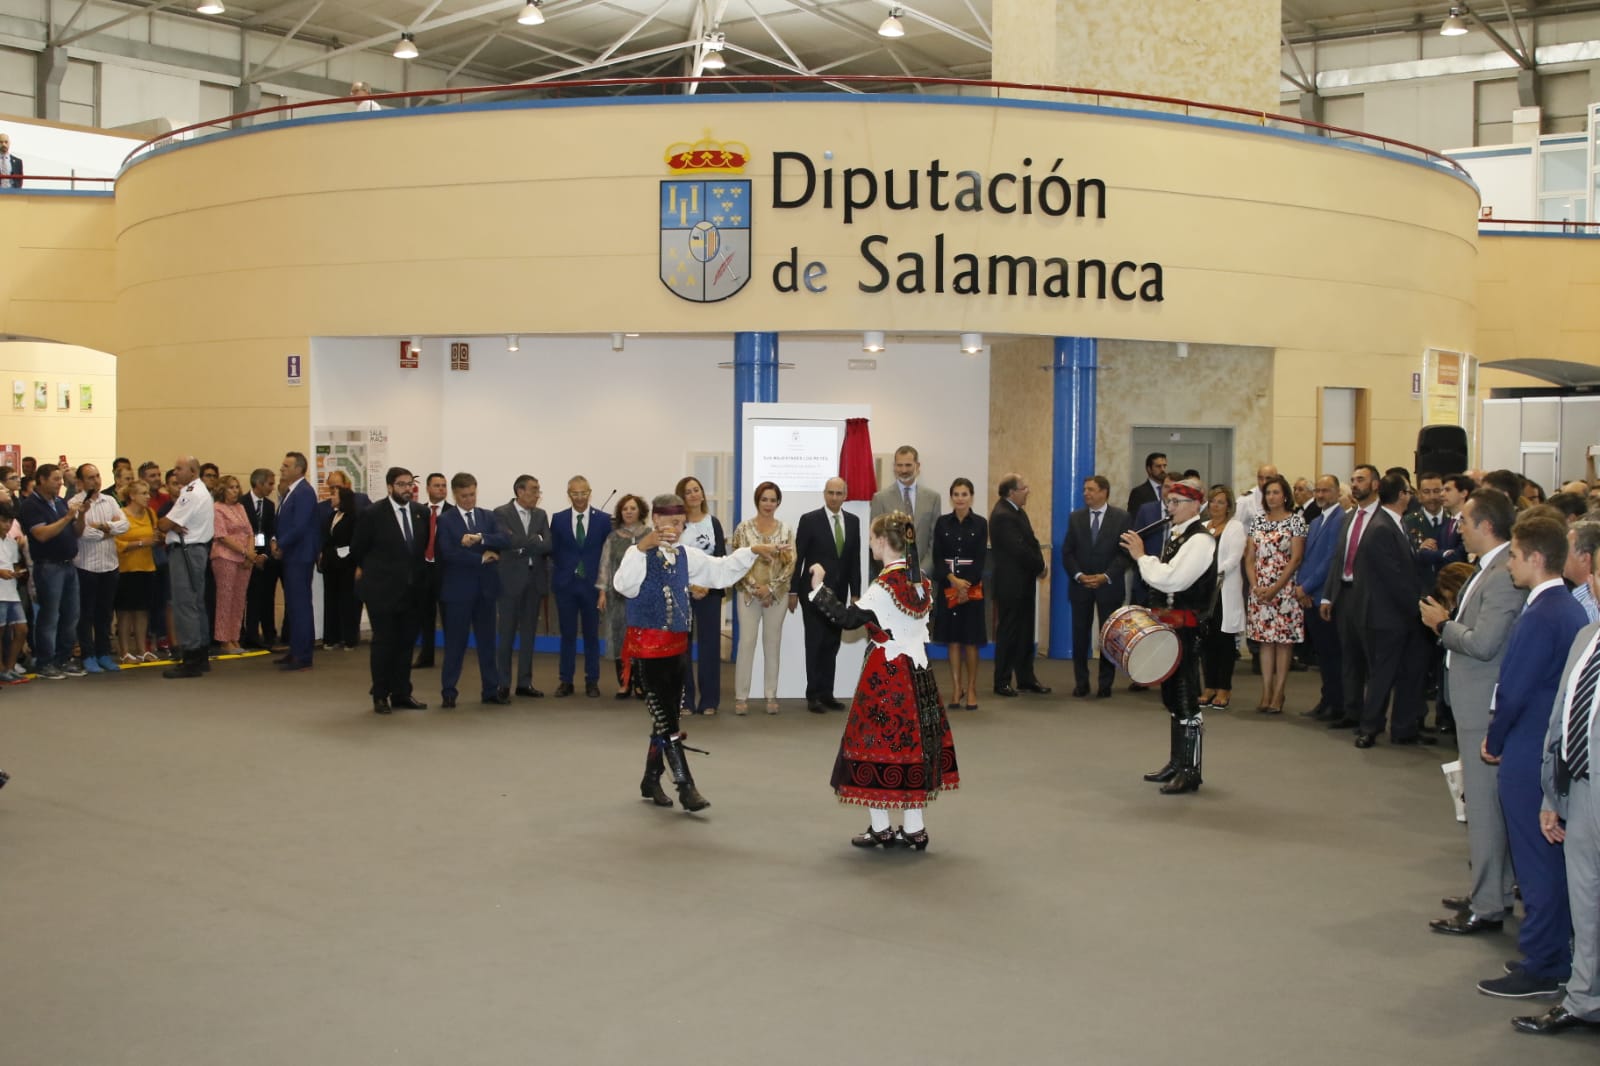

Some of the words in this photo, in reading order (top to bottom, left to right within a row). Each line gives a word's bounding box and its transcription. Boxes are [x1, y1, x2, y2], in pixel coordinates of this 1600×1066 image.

[772, 150, 1106, 225] Diputación
[772, 246, 828, 294] de
[858, 233, 1165, 303] Salamanca
